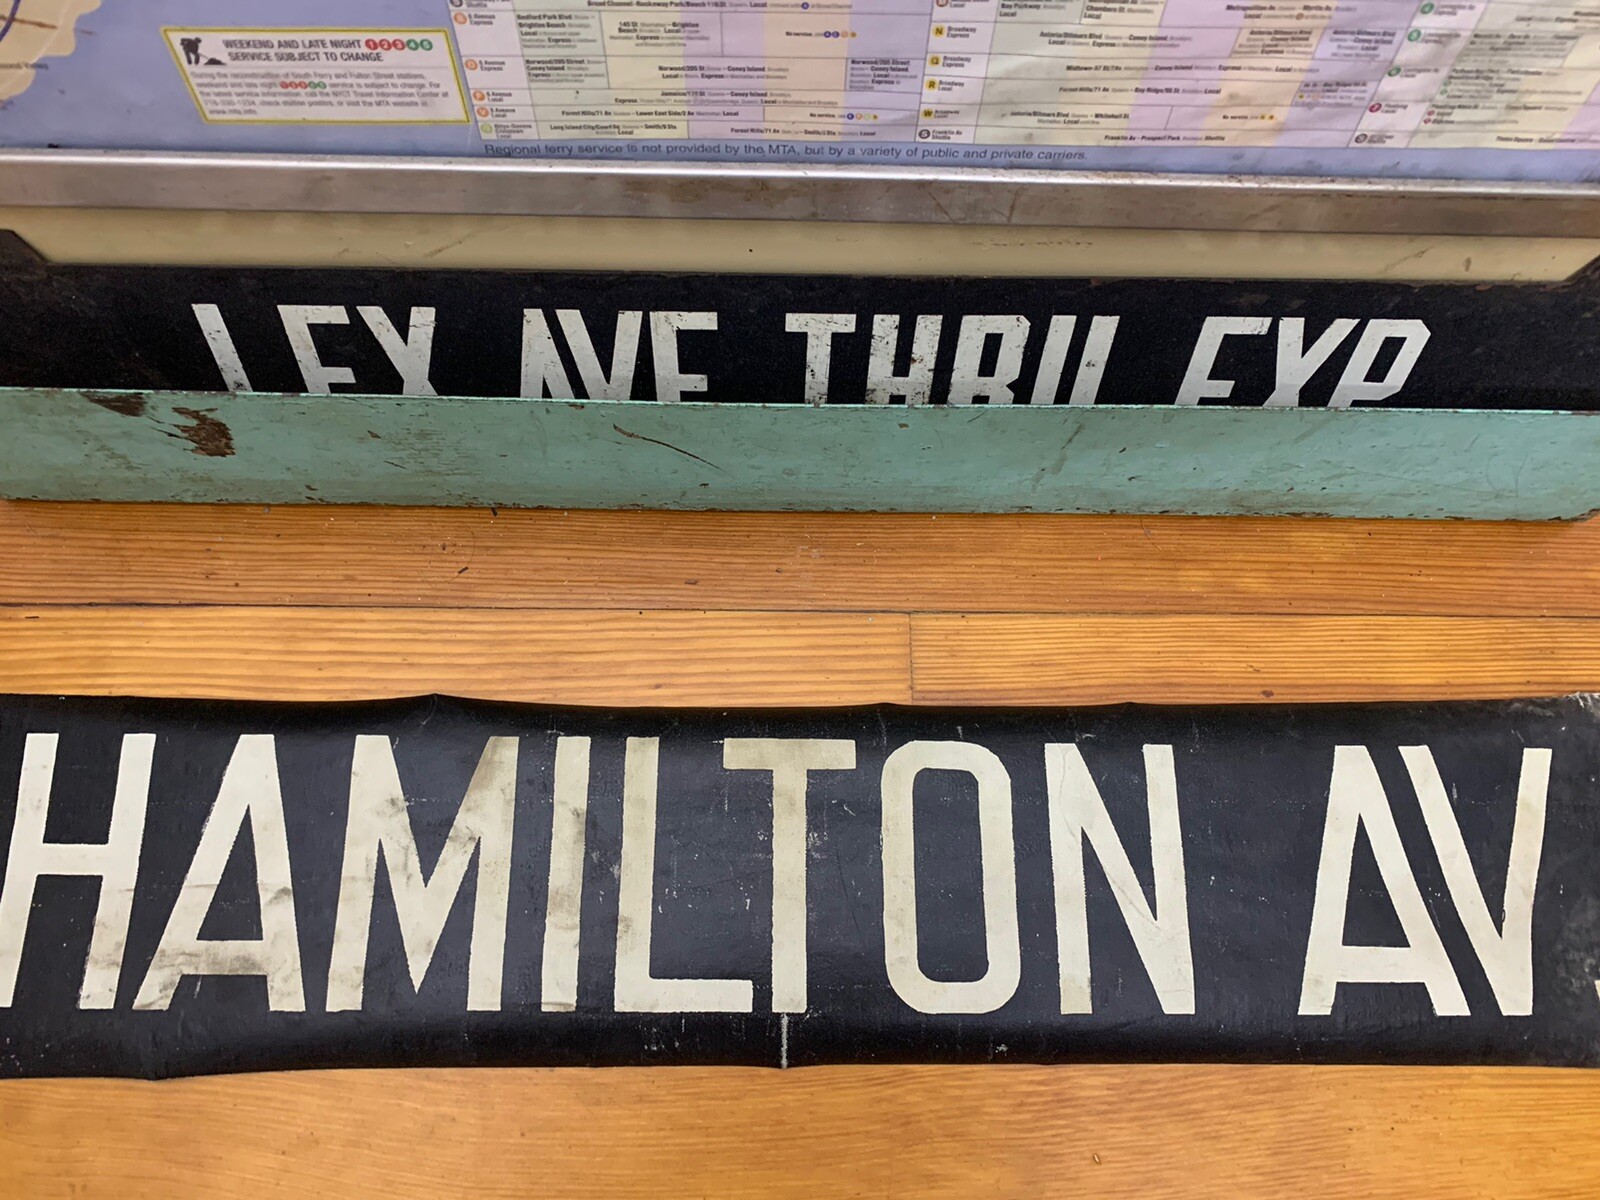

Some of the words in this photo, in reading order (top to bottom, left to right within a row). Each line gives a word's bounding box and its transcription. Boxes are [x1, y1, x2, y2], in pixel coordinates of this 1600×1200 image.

[484, 144, 540, 156] Regional
[578, 144, 622, 153] service
[627, 144, 637, 153] is
[642, 144, 662, 153] not
[666, 144, 720, 156] provided
[724, 144, 740, 156] by
[769, 144, 800, 155] MTA,
[805, 145, 824, 155] but
[829, 145, 843, 157] by
[847, 148, 855, 156] a
[860, 145, 901, 158] variety
[906, 146, 918, 156] of
[922, 146, 959, 159] public
[964, 147, 987, 158] and
[990, 148, 1033, 160] private
[1037, 149, 1088, 160] carriers.
[0, 733, 1196, 1014] HAMILTON
